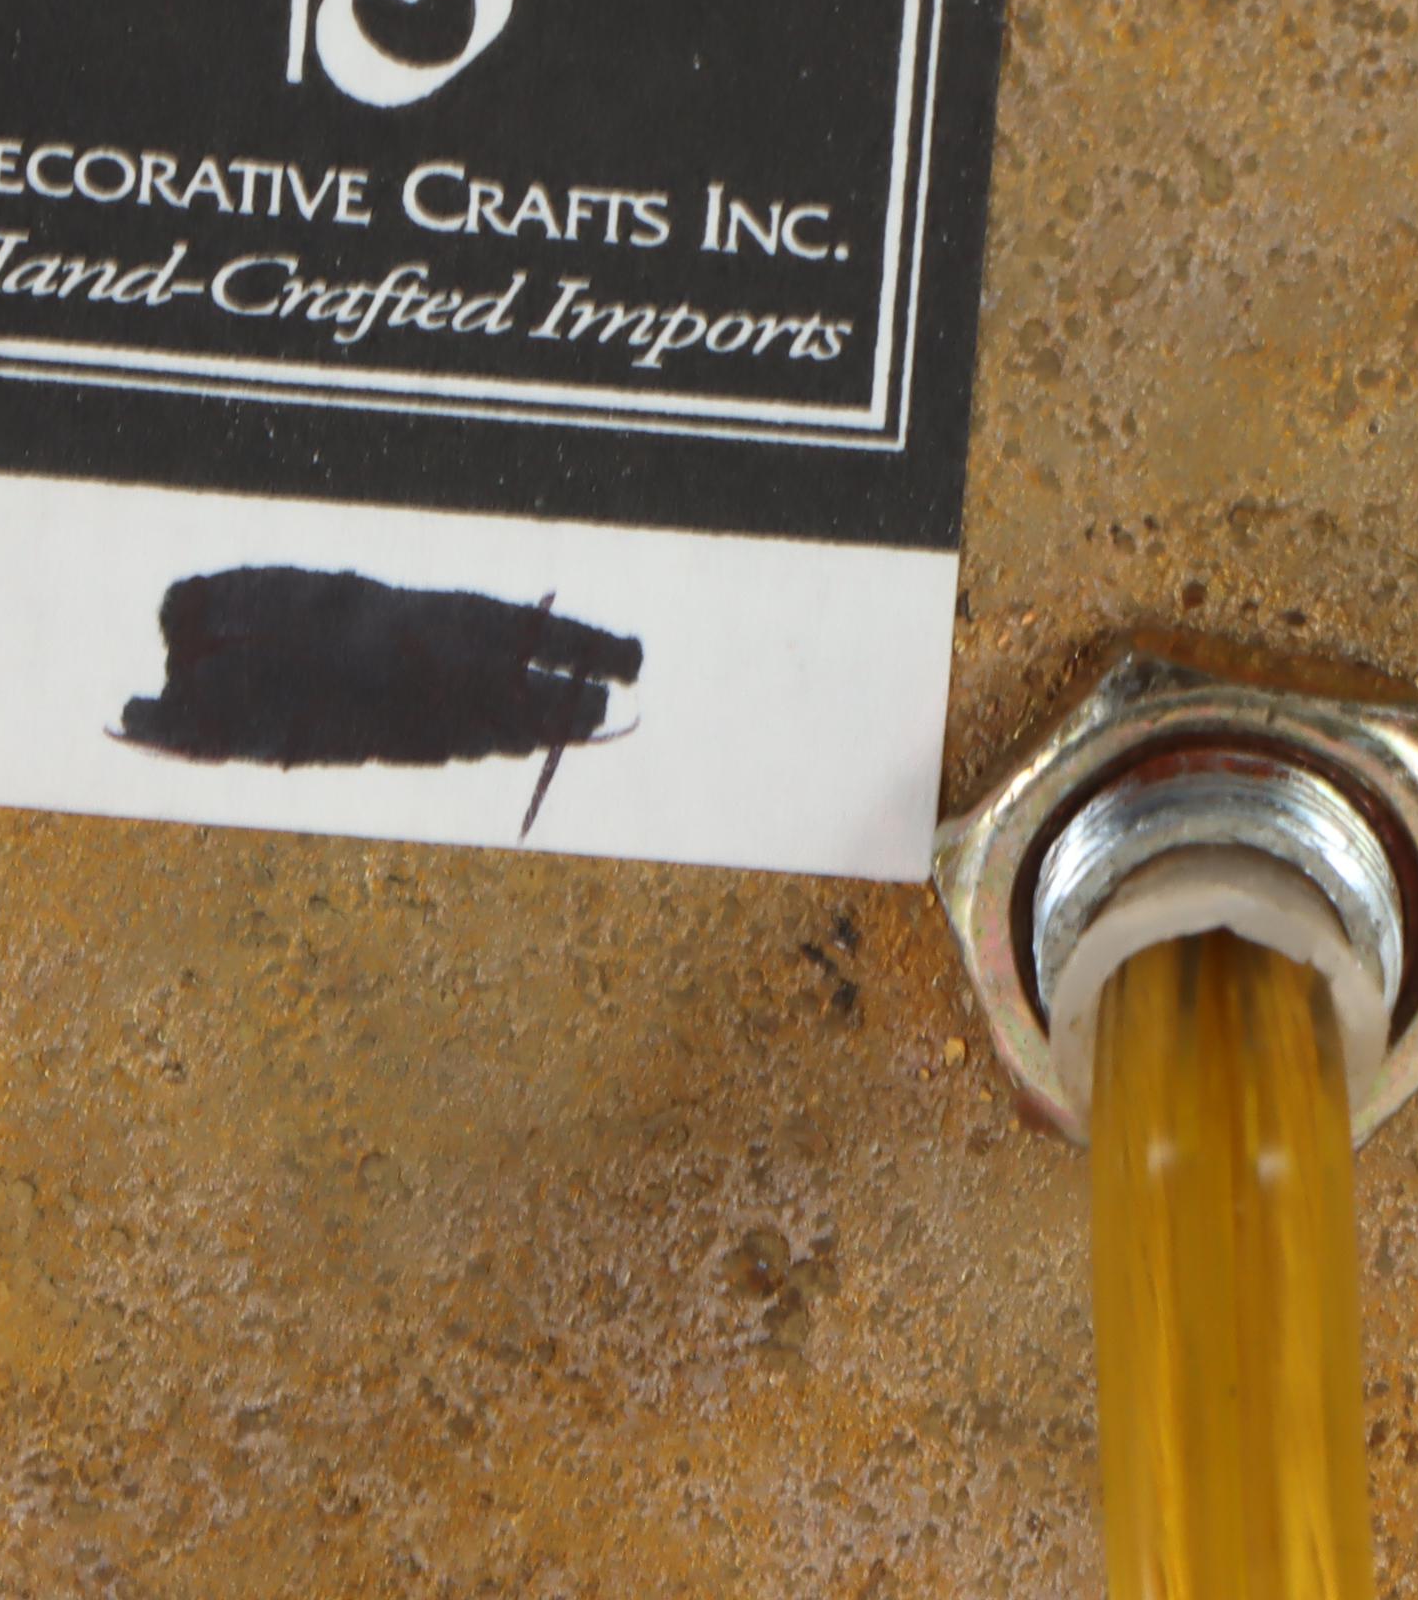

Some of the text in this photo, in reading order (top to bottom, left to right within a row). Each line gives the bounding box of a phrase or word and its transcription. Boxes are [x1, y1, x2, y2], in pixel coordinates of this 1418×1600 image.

[401, 161, 672, 248] CRAFTS
[699, 181, 850, 262] INC.
[527, 275, 854, 370] Imports
